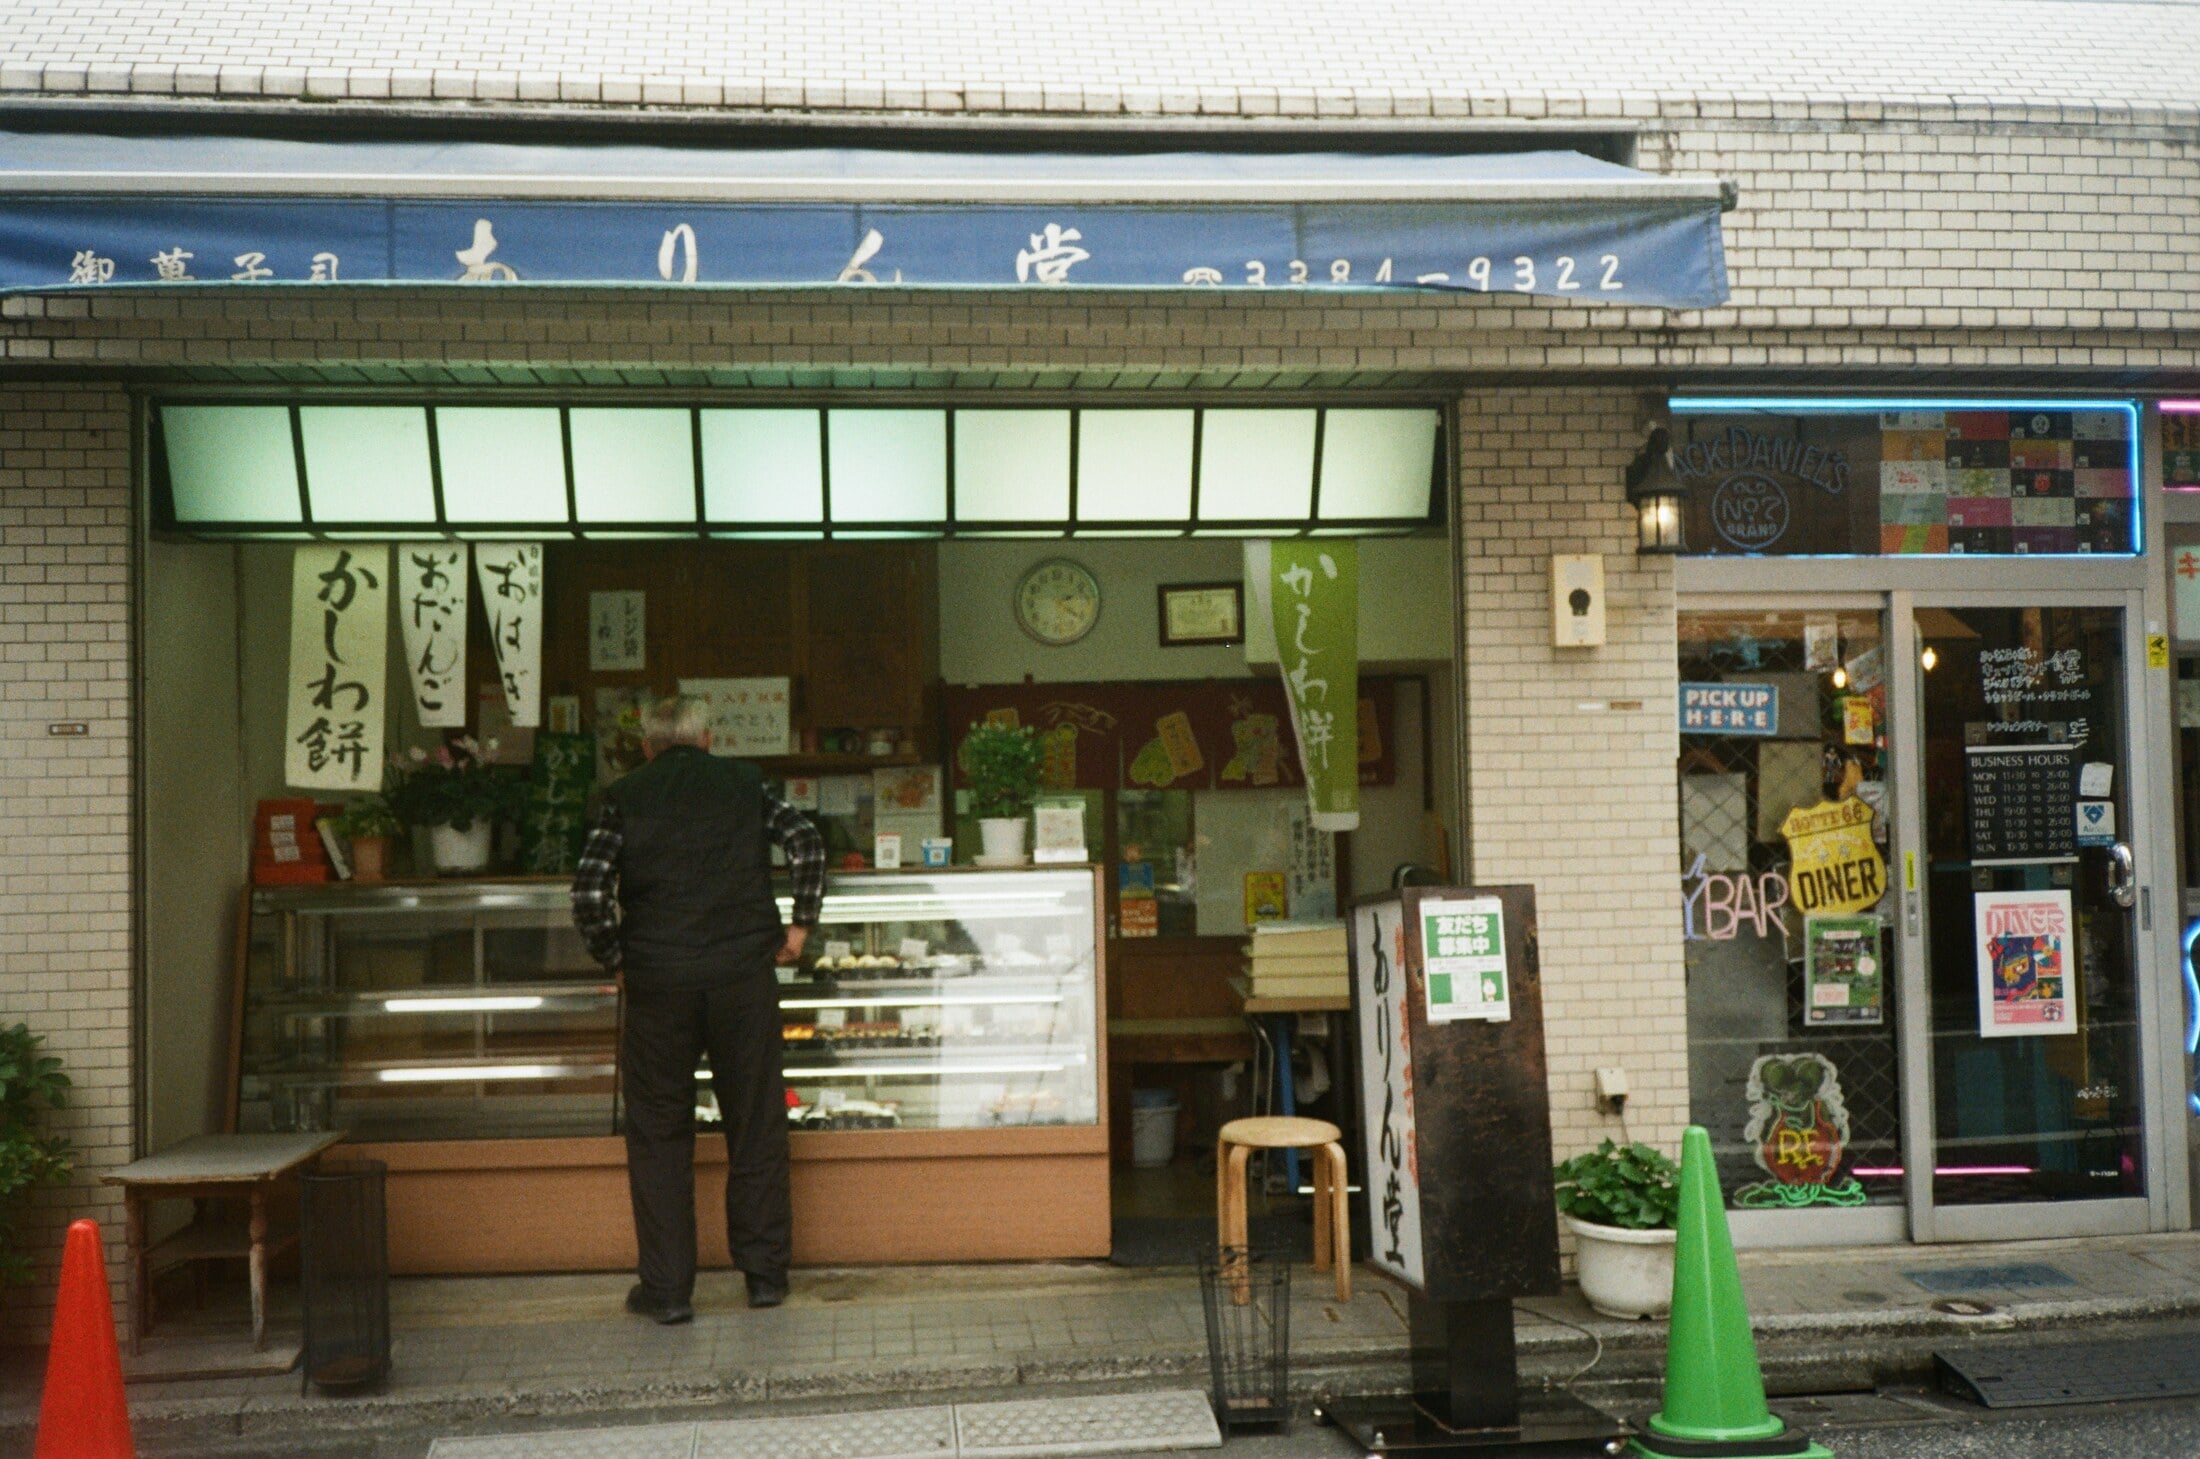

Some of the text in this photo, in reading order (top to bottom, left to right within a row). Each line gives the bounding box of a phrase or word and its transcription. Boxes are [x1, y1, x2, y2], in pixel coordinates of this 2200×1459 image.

[69, 247, 339, 284] 御菓子司
[1673, 436, 1729, 481] ACK
[411, 553, 463, 711] おだんご
[297, 551, 378, 782] かしわ餅
[1686, 689, 1770, 708] PICK UP
[1971, 754, 2070, 768] BUSINESS HOURS
[1973, 773, 1996, 781] MON
[1974, 784, 1991, 793] TUE
[1974, 796, 1996, 805] WED
[1842, 802, 1863, 822] 66
[1975, 808, 1995, 817] THU
[1975, 820, 1989, 829] FRI
[1976, 831, 1992, 839] SAT
[1976, 843, 1996, 851] SUN
[1798, 857, 1879, 910] DINER
[1705, 872, 1790, 939] BAR
[1436, 916, 1489, 935] 友だち
[1372, 912, 1406, 1267] ありん堂
